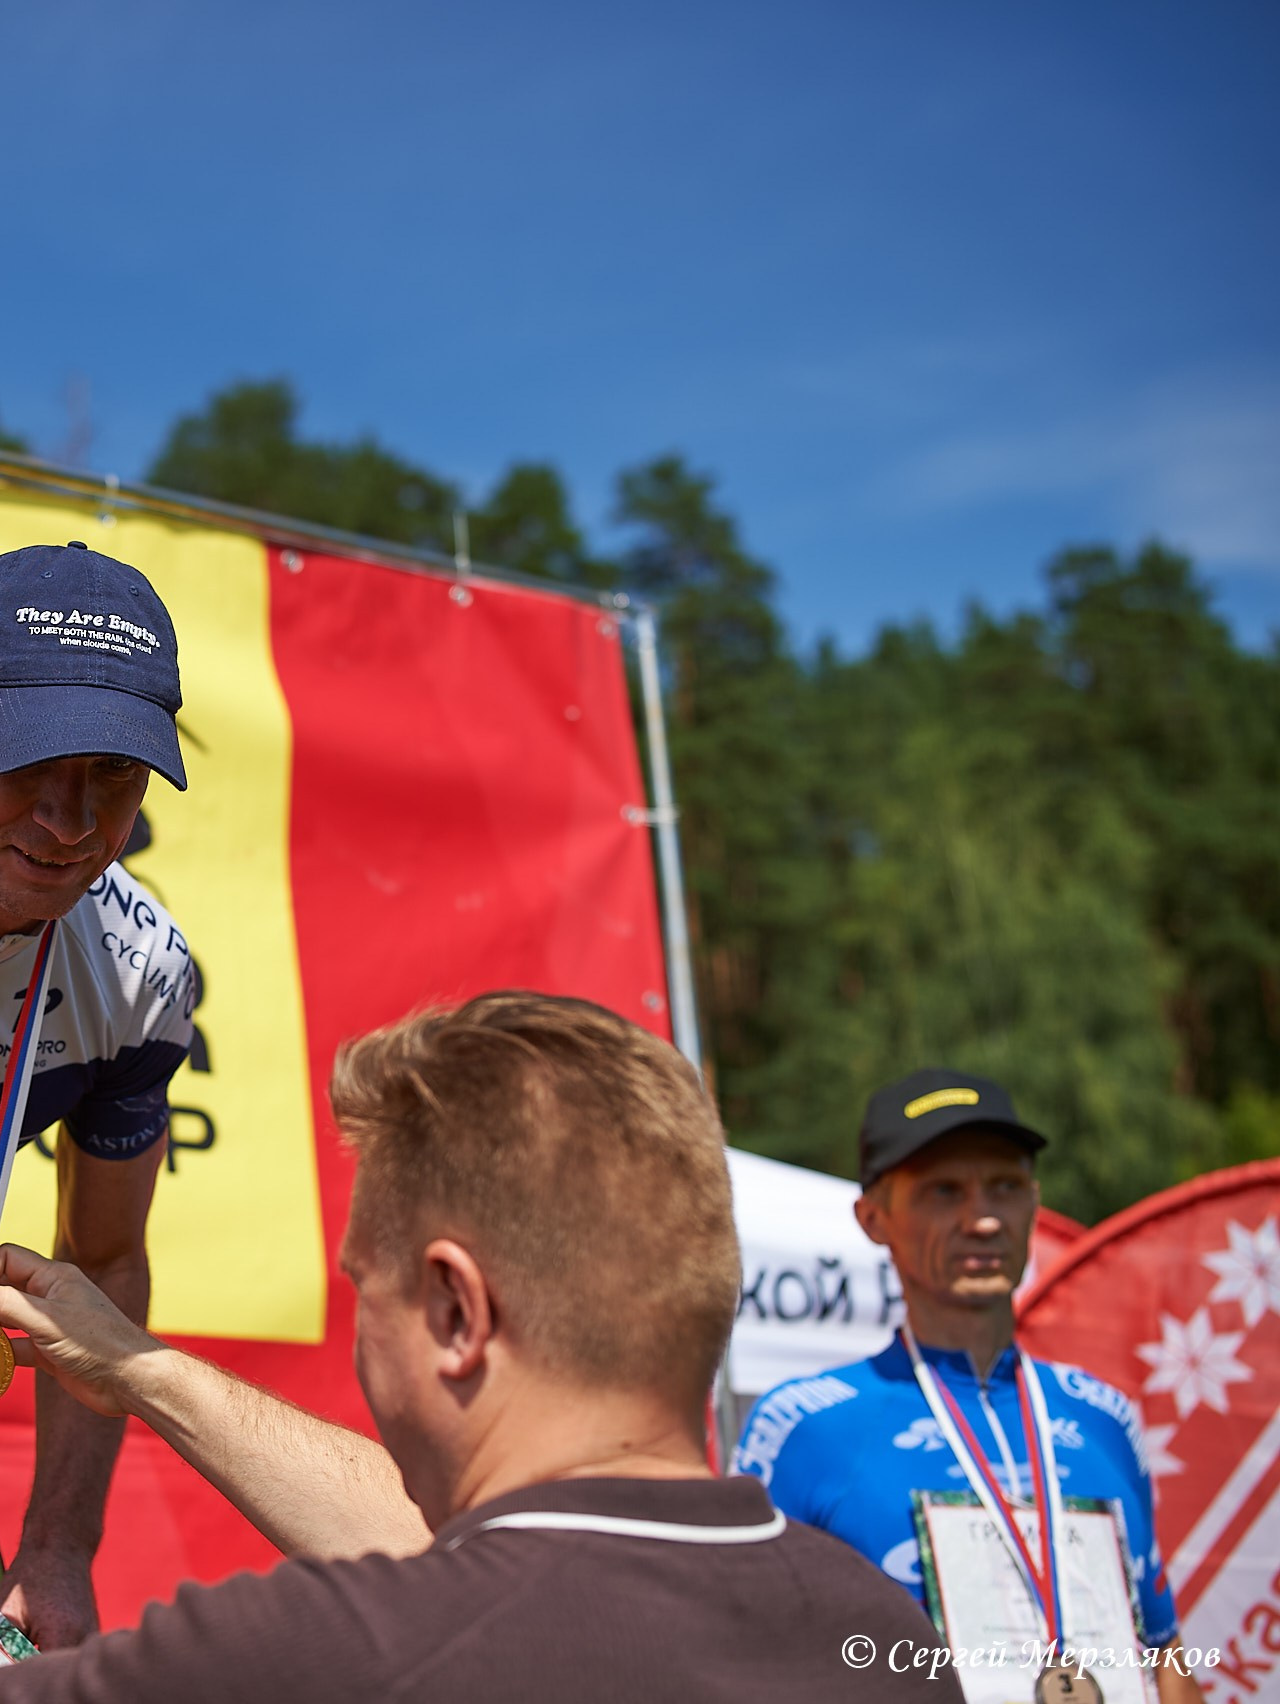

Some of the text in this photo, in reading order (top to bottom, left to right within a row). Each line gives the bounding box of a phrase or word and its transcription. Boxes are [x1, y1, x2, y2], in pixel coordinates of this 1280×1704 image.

[16, 607, 64, 625] They
[65, 609, 104, 627] Are
[29, 626, 41, 635] TO
[41, 626, 64, 635] MEET
[63, 628, 87, 638] BOTH
[87, 630, 105, 640] THE
[59, 637, 82, 646] when
